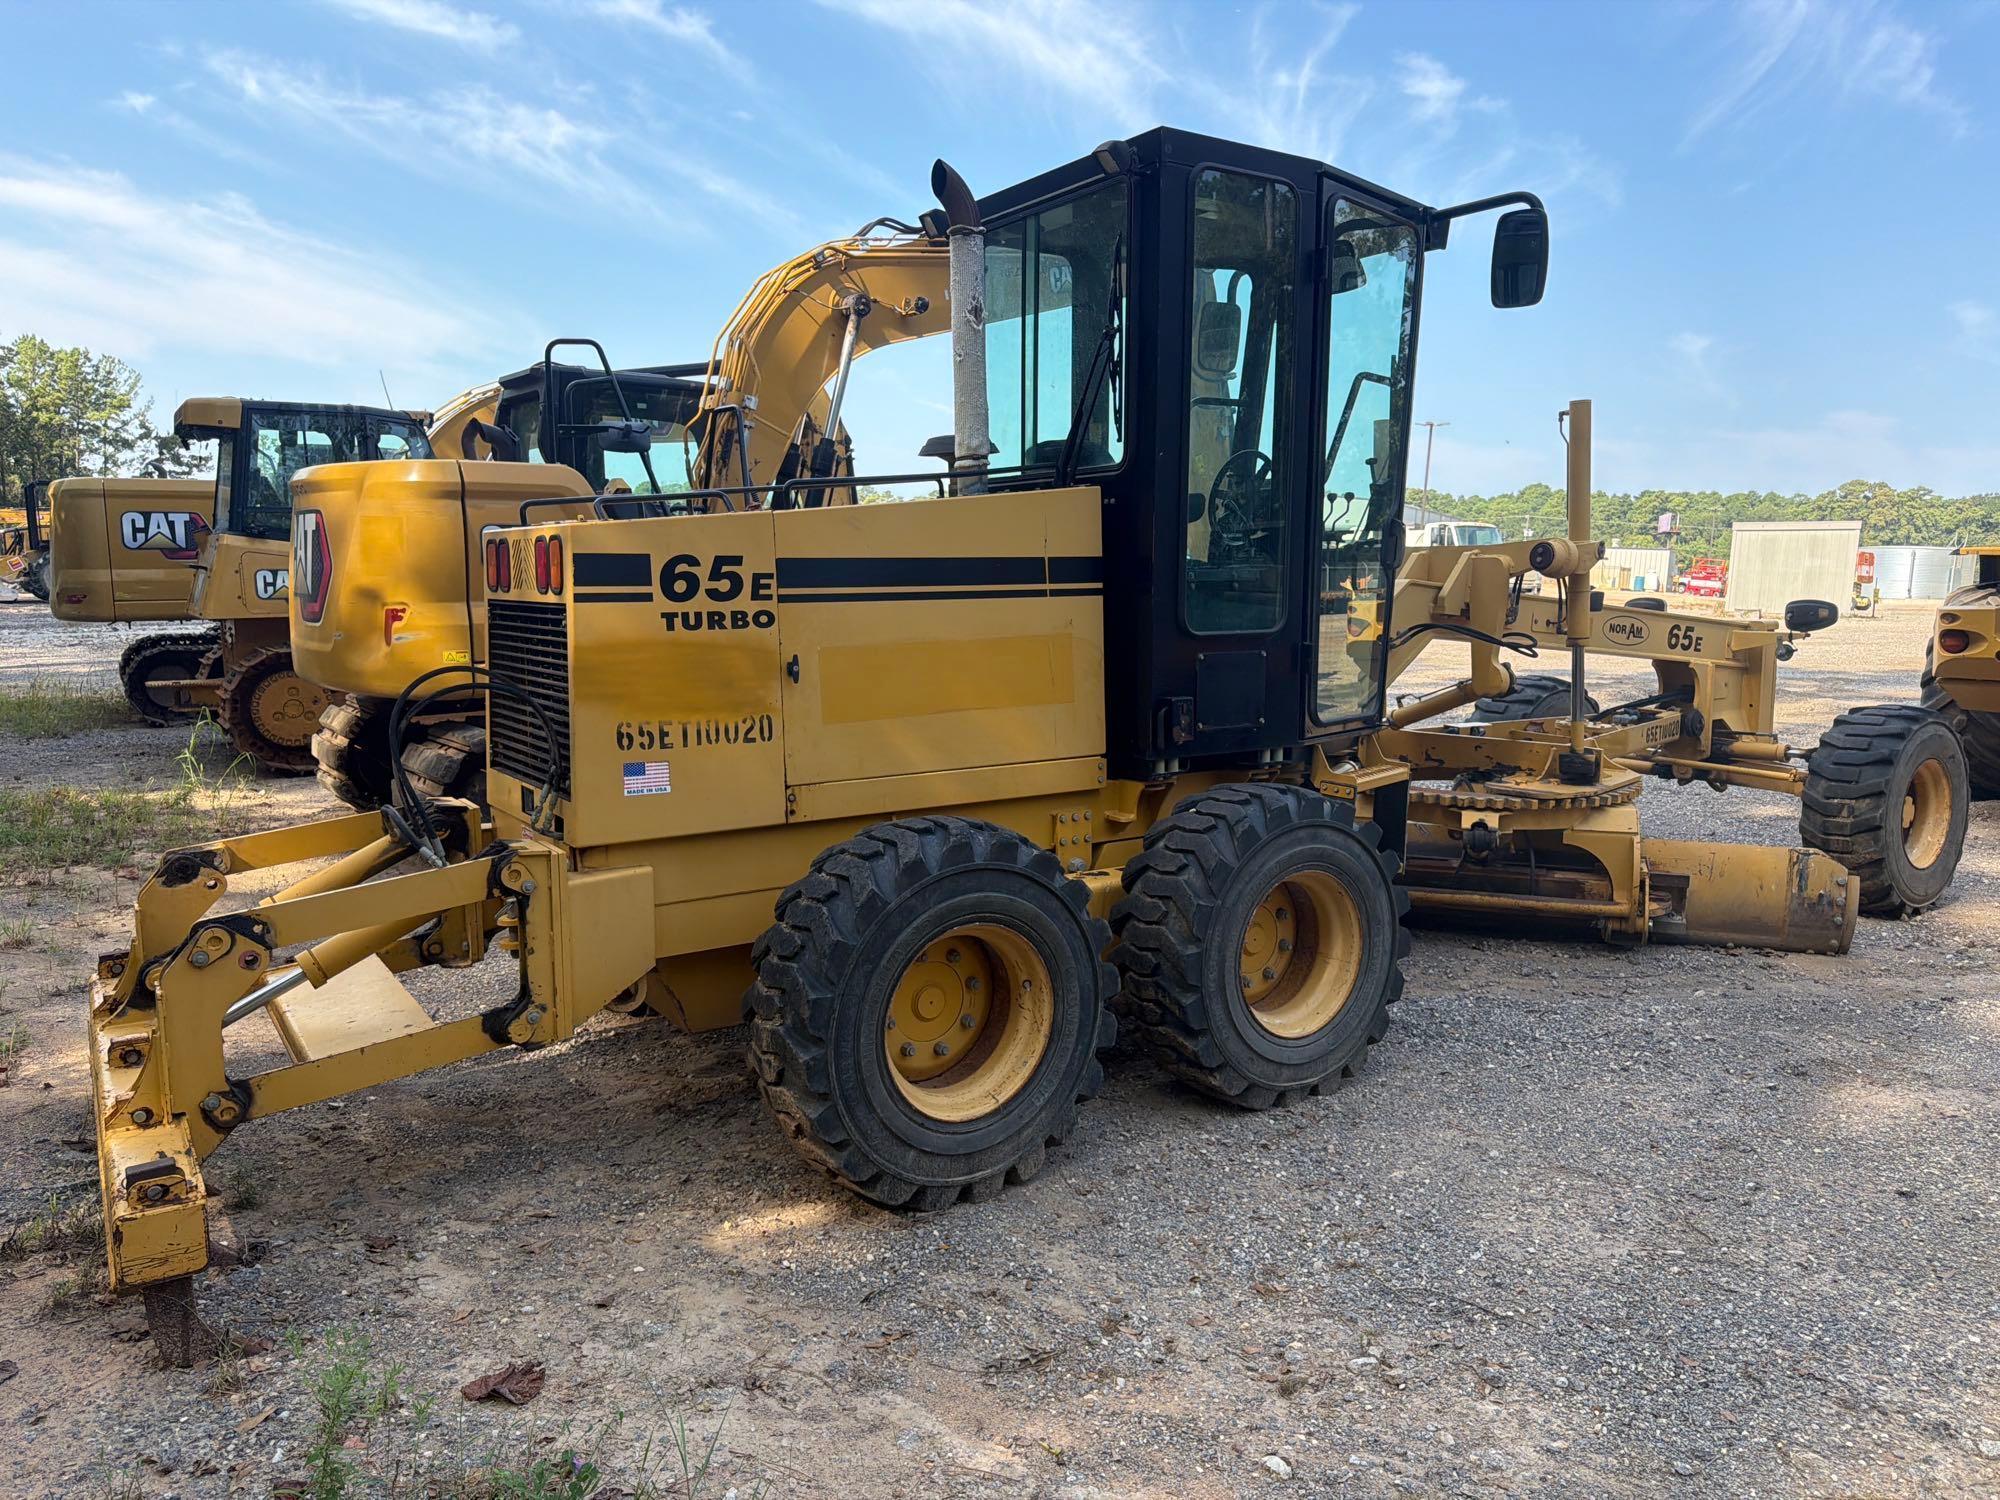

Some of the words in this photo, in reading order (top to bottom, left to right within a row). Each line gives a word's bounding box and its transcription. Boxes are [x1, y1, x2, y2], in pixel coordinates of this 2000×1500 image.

[1049, 265, 1073, 292] CA
[121, 512, 190, 549] CAT
[294, 512, 317, 596] AT
[255, 569, 289, 599] CA
[659, 553, 775, 603] 65E
[660, 609, 776, 632] TURBO
[1666, 623, 1703, 652] 65E
